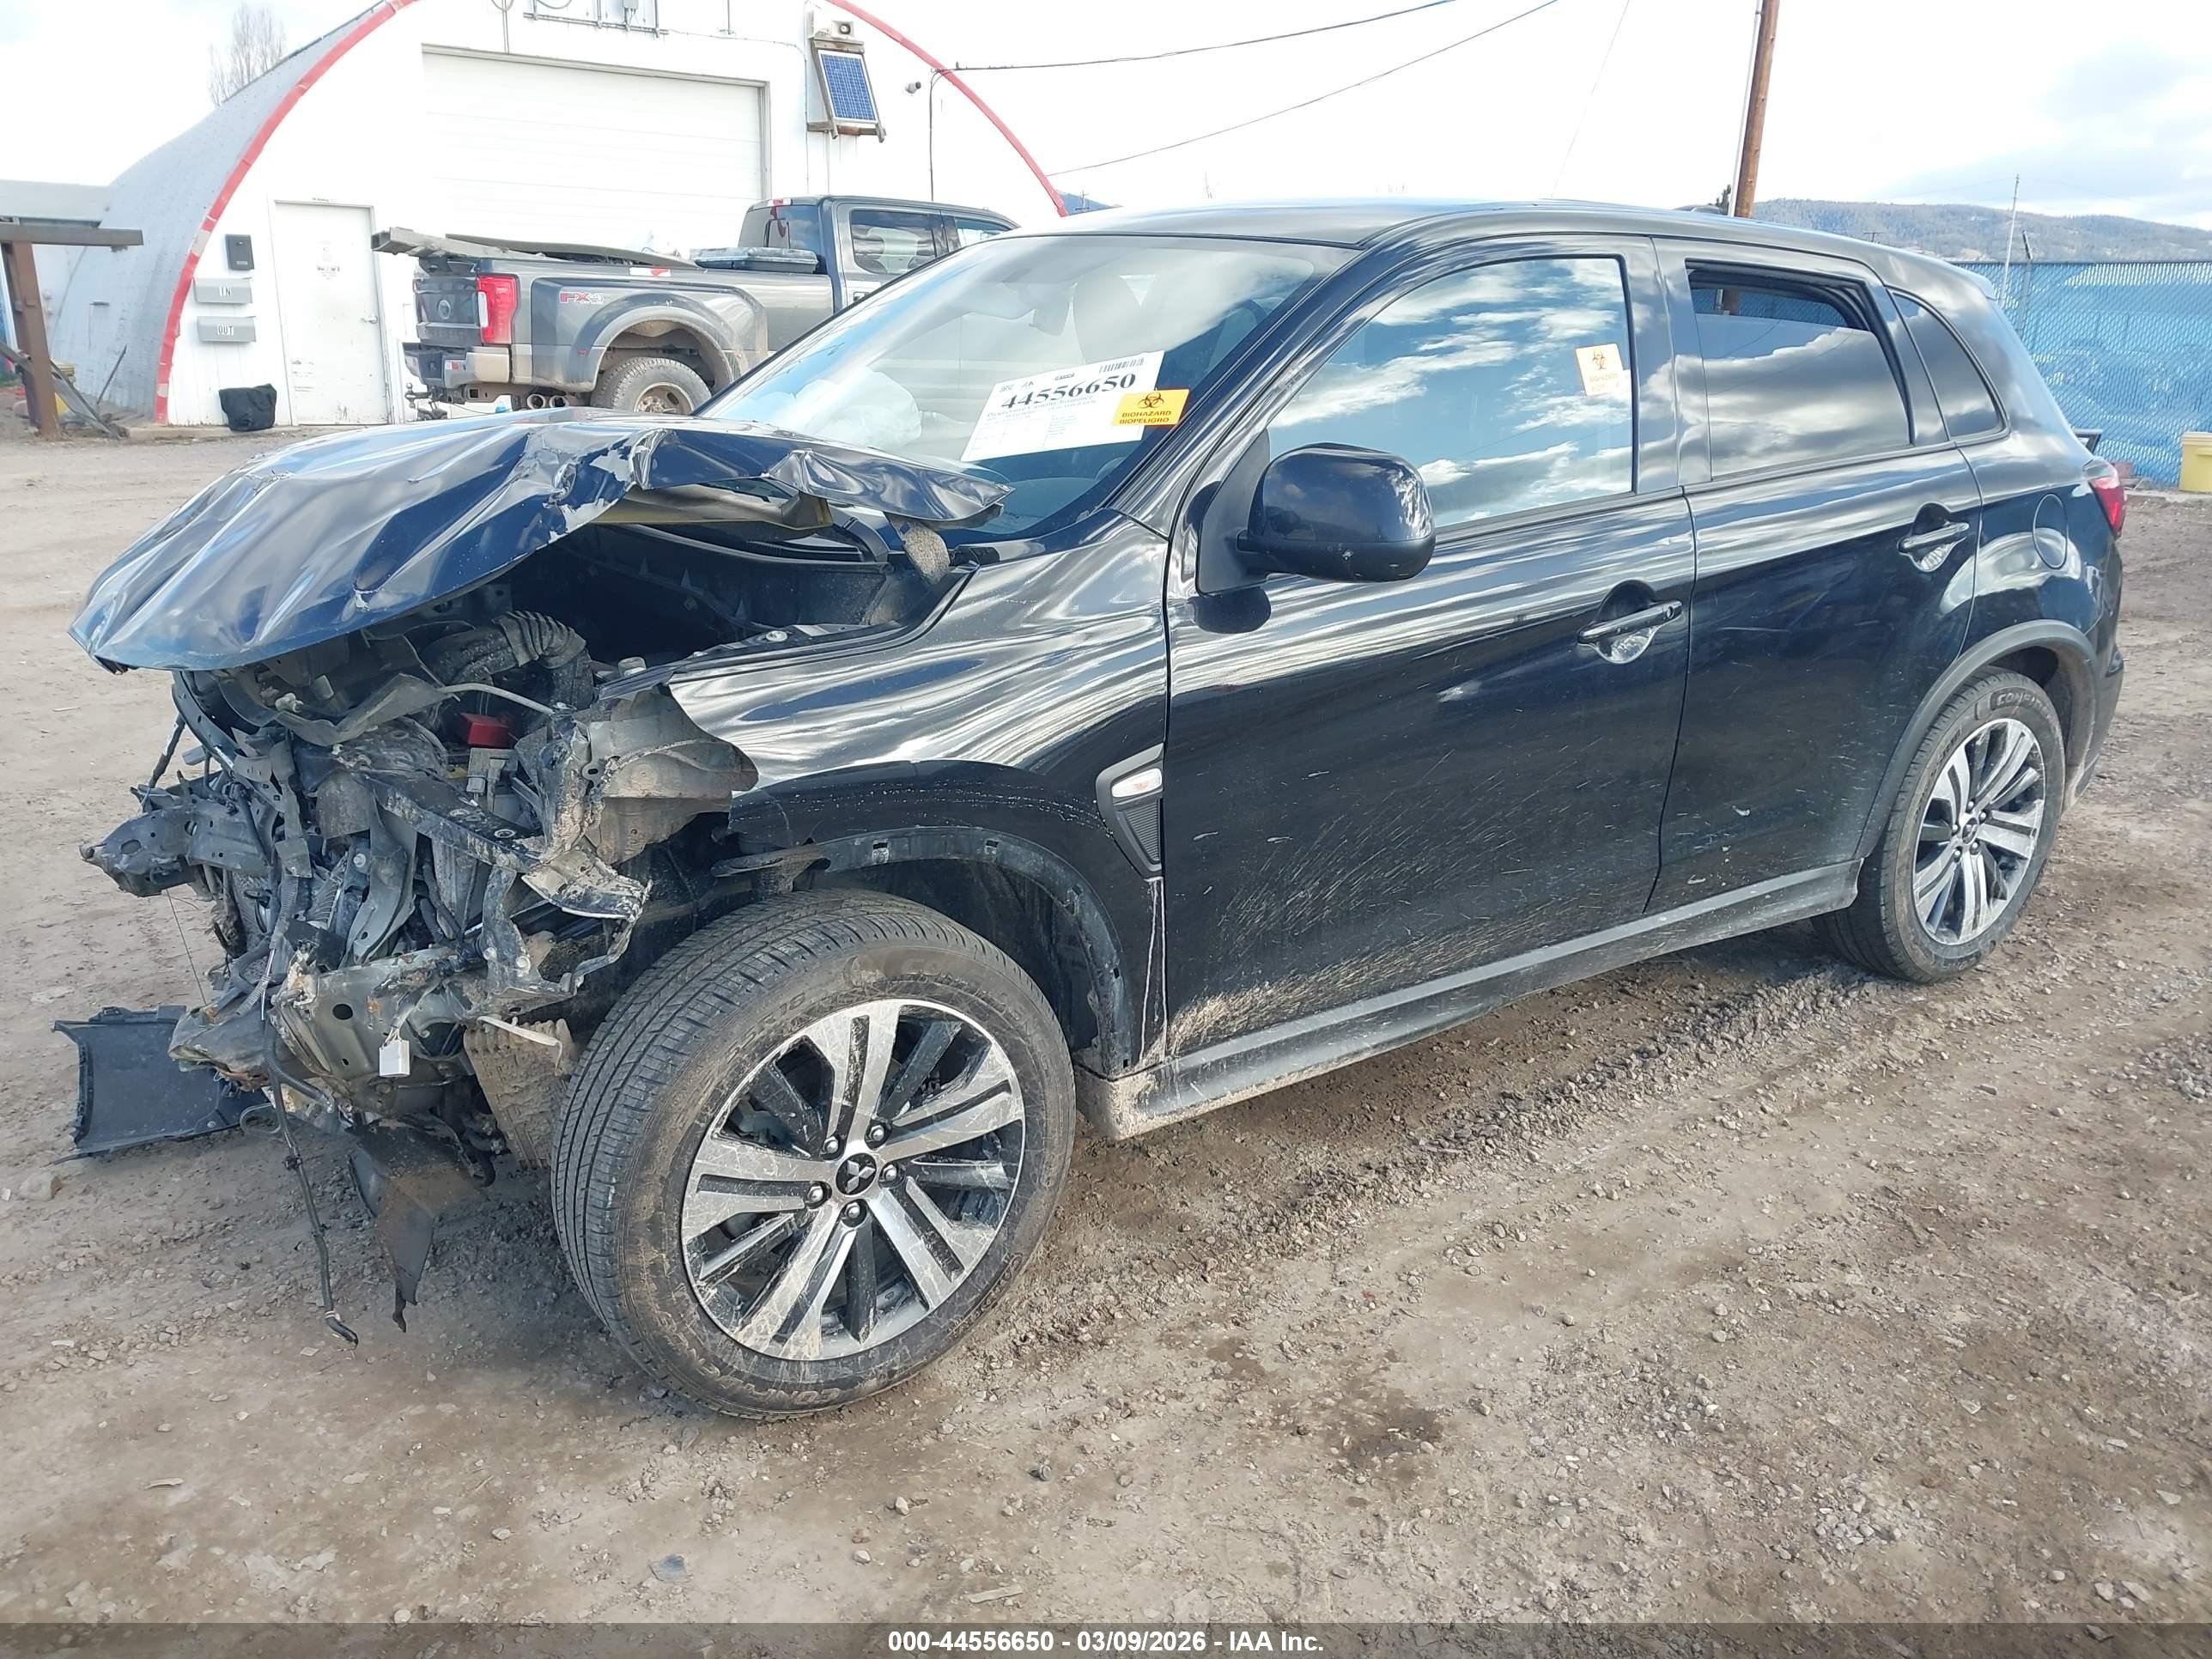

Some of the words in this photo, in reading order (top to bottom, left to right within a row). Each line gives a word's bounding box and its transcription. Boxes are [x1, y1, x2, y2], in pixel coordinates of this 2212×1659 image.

[221, 287, 232, 296] IN
[217, 325, 234, 335] OUT
[1001, 373, 1136, 410] 44556650
